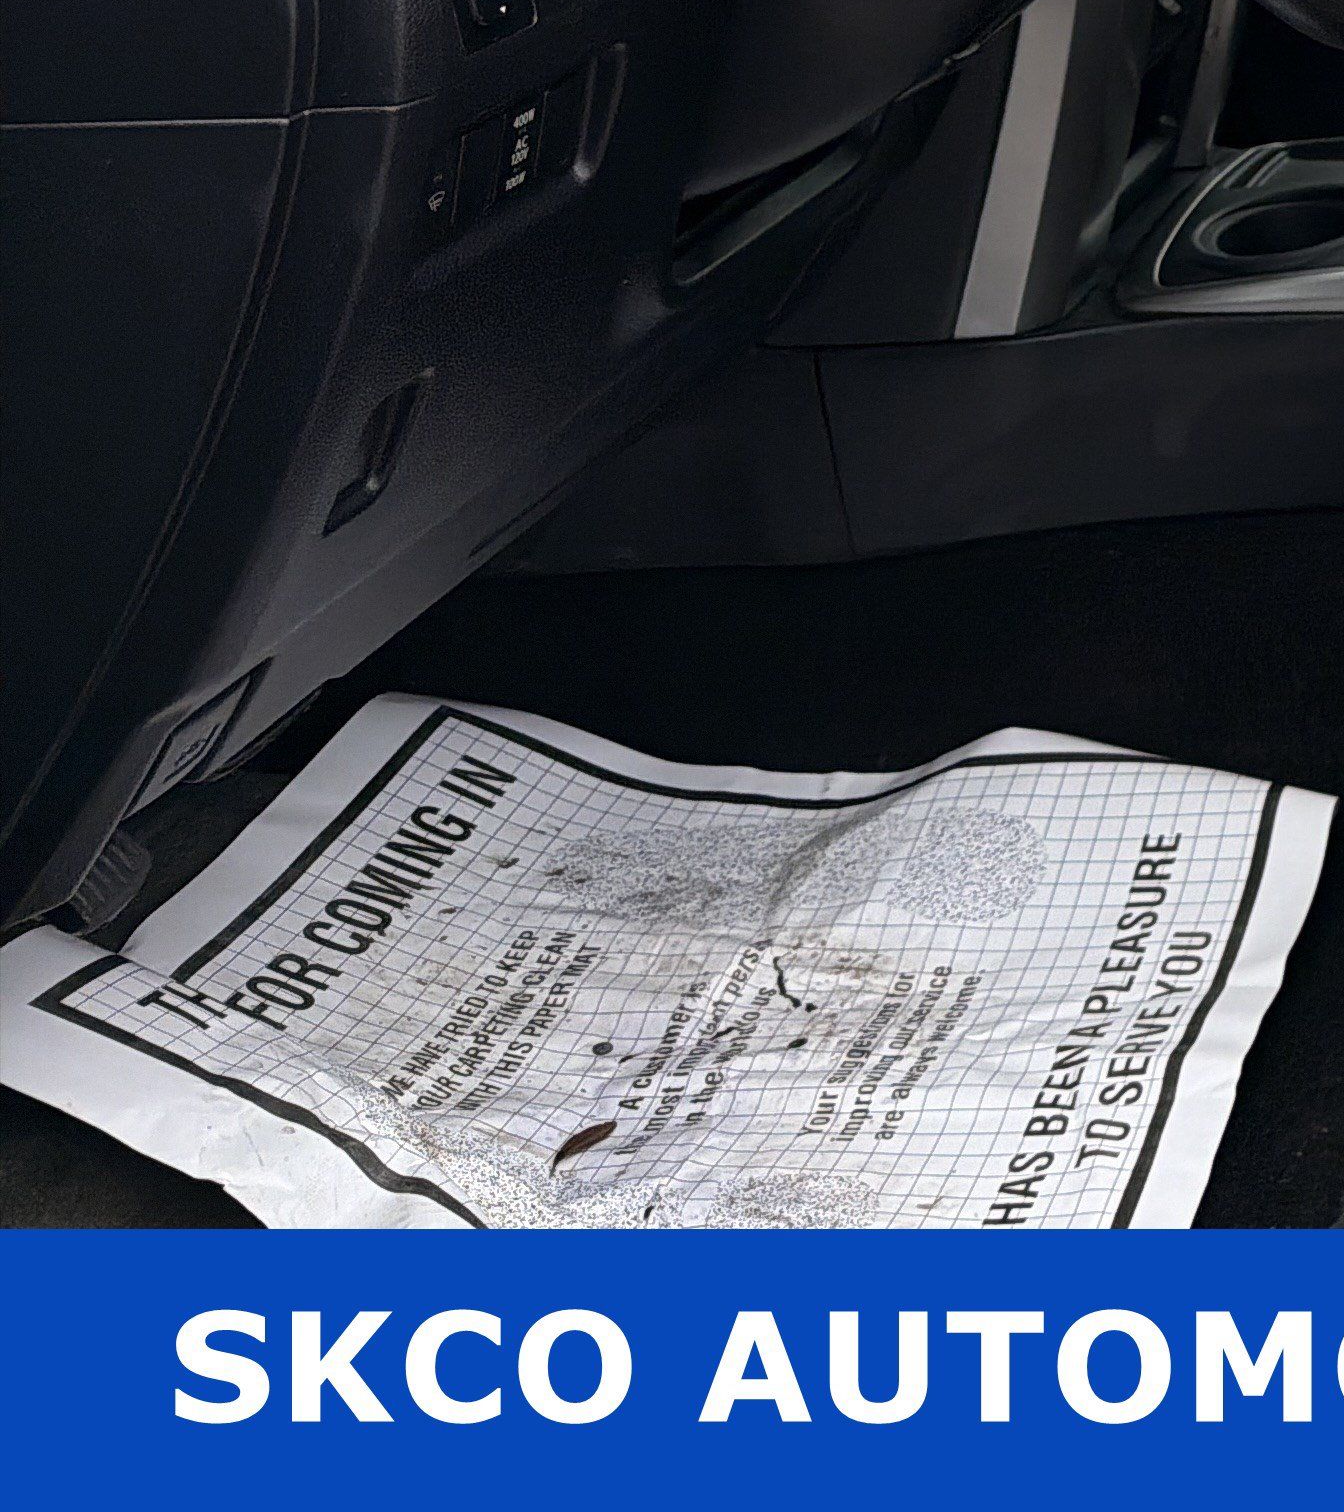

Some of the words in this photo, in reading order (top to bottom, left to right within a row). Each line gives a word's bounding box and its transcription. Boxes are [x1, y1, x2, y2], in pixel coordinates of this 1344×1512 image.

[515, 135, 528, 151] AC
[224, 952, 343, 1032] FOR
[303, 804, 478, 956] COMING
[438, 754, 519, 809] IN
[1083, 831, 1183, 1017] PLEASURE
[401, 1041, 450, 1076] HAVE
[434, 996, 489, 1042] TRIED
[475, 974, 509, 995] TO
[496, 930, 540, 973] KEEP
[448, 991, 535, 1078] CARPETING
[522, 931, 577, 988] CLEAN
[751, 986, 777, 1007] us
[1156, 930, 1214, 1005] YOU
[453, 1081, 503, 1111] WITH
[486, 1040, 534, 1079] THIS
[519, 981, 574, 1037] PAPER
[560, 941, 601, 977] MAT
[618, 1096, 645, 1111] A
[632, 1002, 696, 1089] customer
[798, 1090, 839, 1137] Your
[827, 1001, 903, 1085] suggestions
[886, 972, 916, 998] for
[829, 1054, 905, 1143] improving
[889, 1025, 917, 1051] our
[906, 965, 953, 1027] service
[1068, 1013, 1114, 1047] A
[1098, 1002, 1180, 1107] SERVE
[644, 1085, 684, 1132] most
[675, 1109, 707, 1128] in
[690, 1071, 724, 1104] the
[874, 1109, 905, 1141] are
[890, 1045, 939, 1101] always
[1022, 1044, 1092, 1138] BEEN
[983, 1150, 1056, 1226] HAS
[1074, 1118, 1132, 1170] TO
